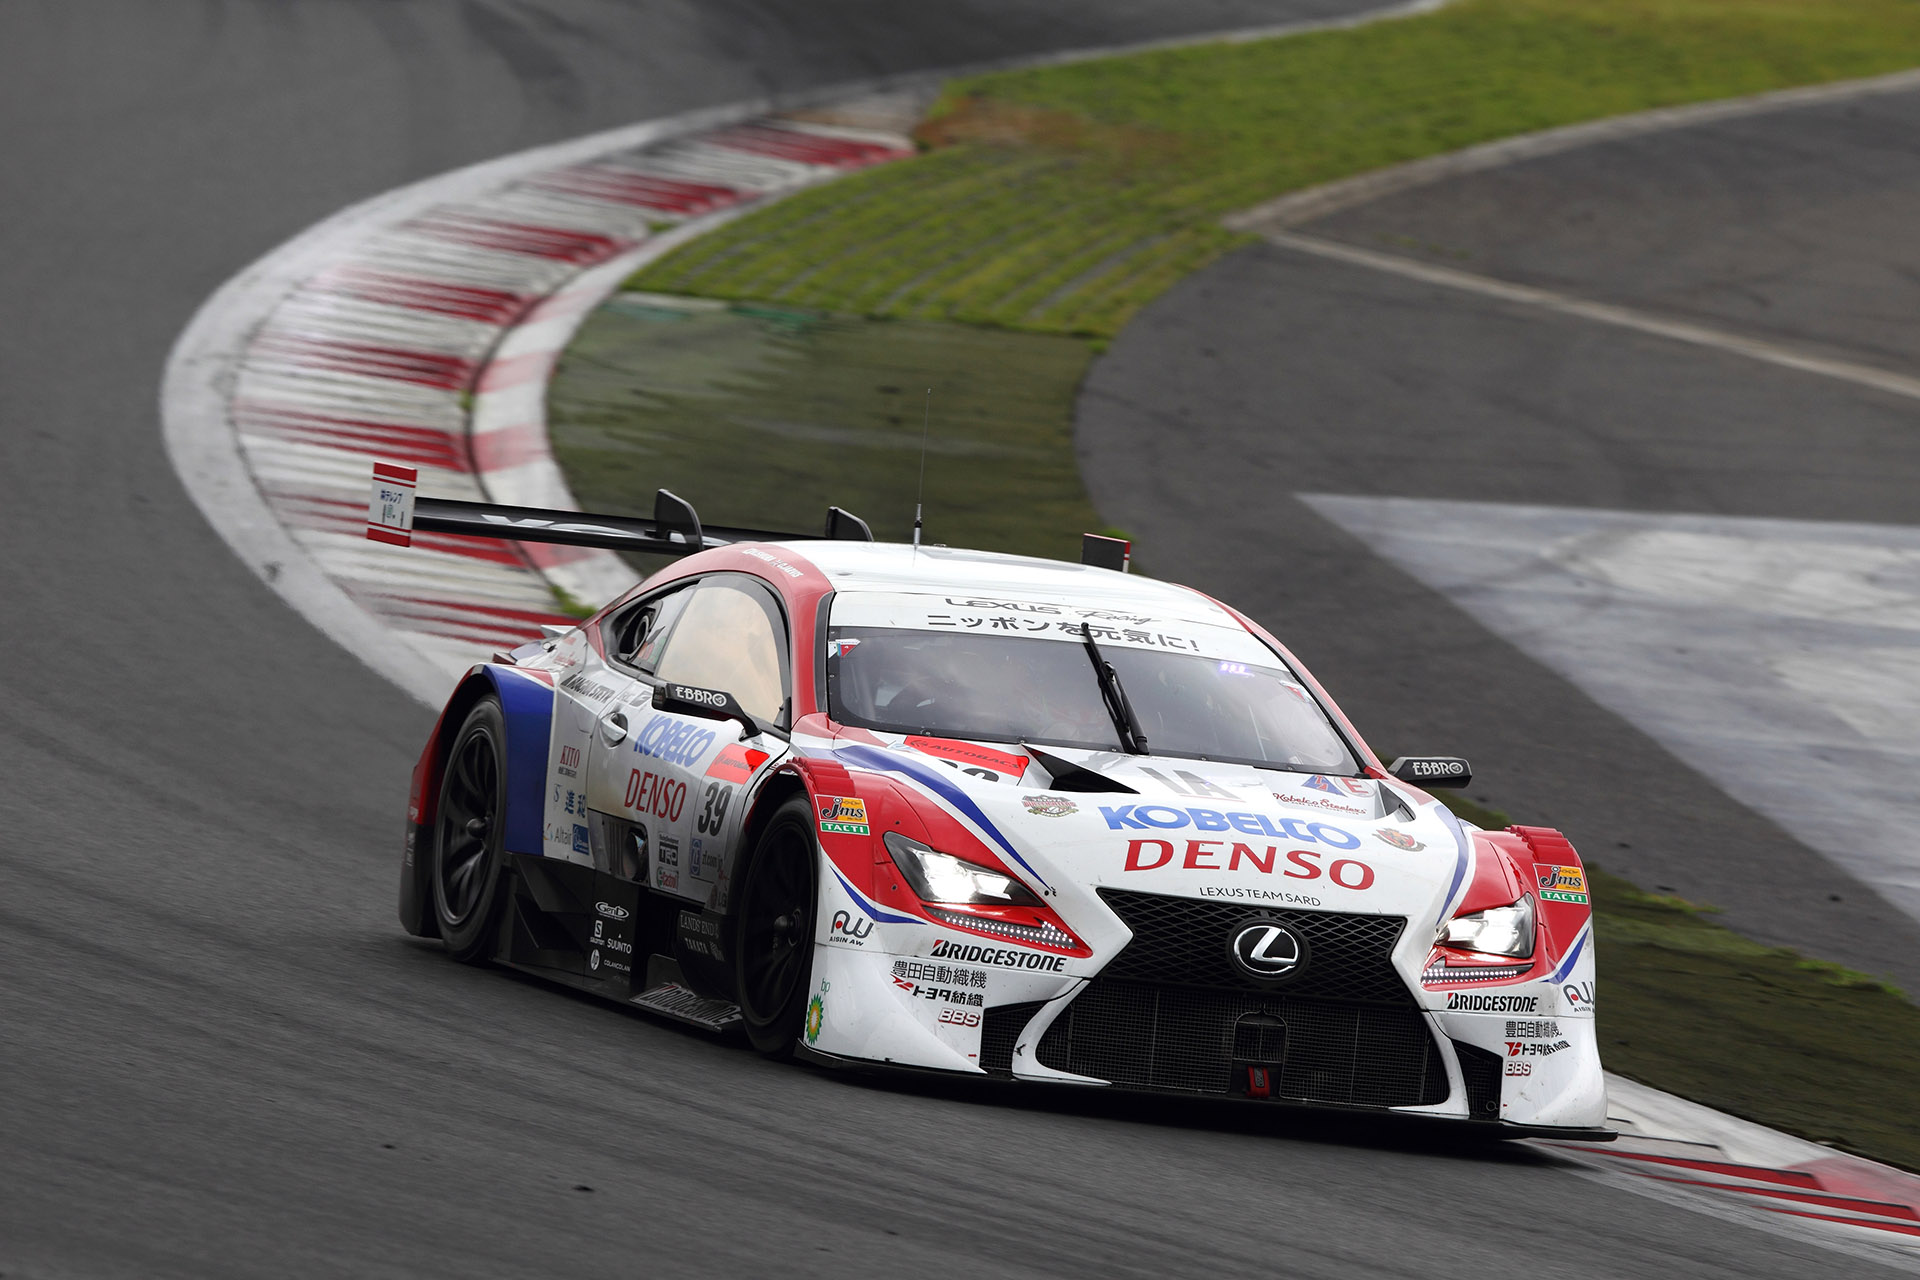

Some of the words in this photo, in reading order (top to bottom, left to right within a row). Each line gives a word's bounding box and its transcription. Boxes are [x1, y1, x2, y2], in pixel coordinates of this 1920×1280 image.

[945, 598, 1062, 615] LEXUS
[676, 686, 728, 708] EBBRO
[633, 714, 716, 768] KOBELCO
[560, 745, 580, 769] KITO
[1412, 760, 1464, 776] EBBRO
[624, 767, 687, 823] DENSO
[1272, 792, 1319, 807] Kobelco
[697, 781, 734, 837] 39
[821, 797, 864, 819] jms
[825, 823, 864, 833] TACTI
[1098, 804, 1362, 850] KOBELCO
[1123, 838, 1375, 891] DENSO
[1540, 866, 1582, 887] jms
[1199, 887, 1244, 899] LEXUS
[1244, 889, 1285, 903] TEAM
[1284, 894, 1321, 907] SARD
[1544, 891, 1582, 902] TACTI
[607, 938, 632, 954] SUUNTO
[931, 939, 1068, 972] BRIDGESTONE
[821, 978, 831, 996] bp
[1447, 992, 1539, 1013] BRIDGESTONE
[938, 1007, 980, 1027] BBS
[1504, 1060, 1532, 1077] BBS
